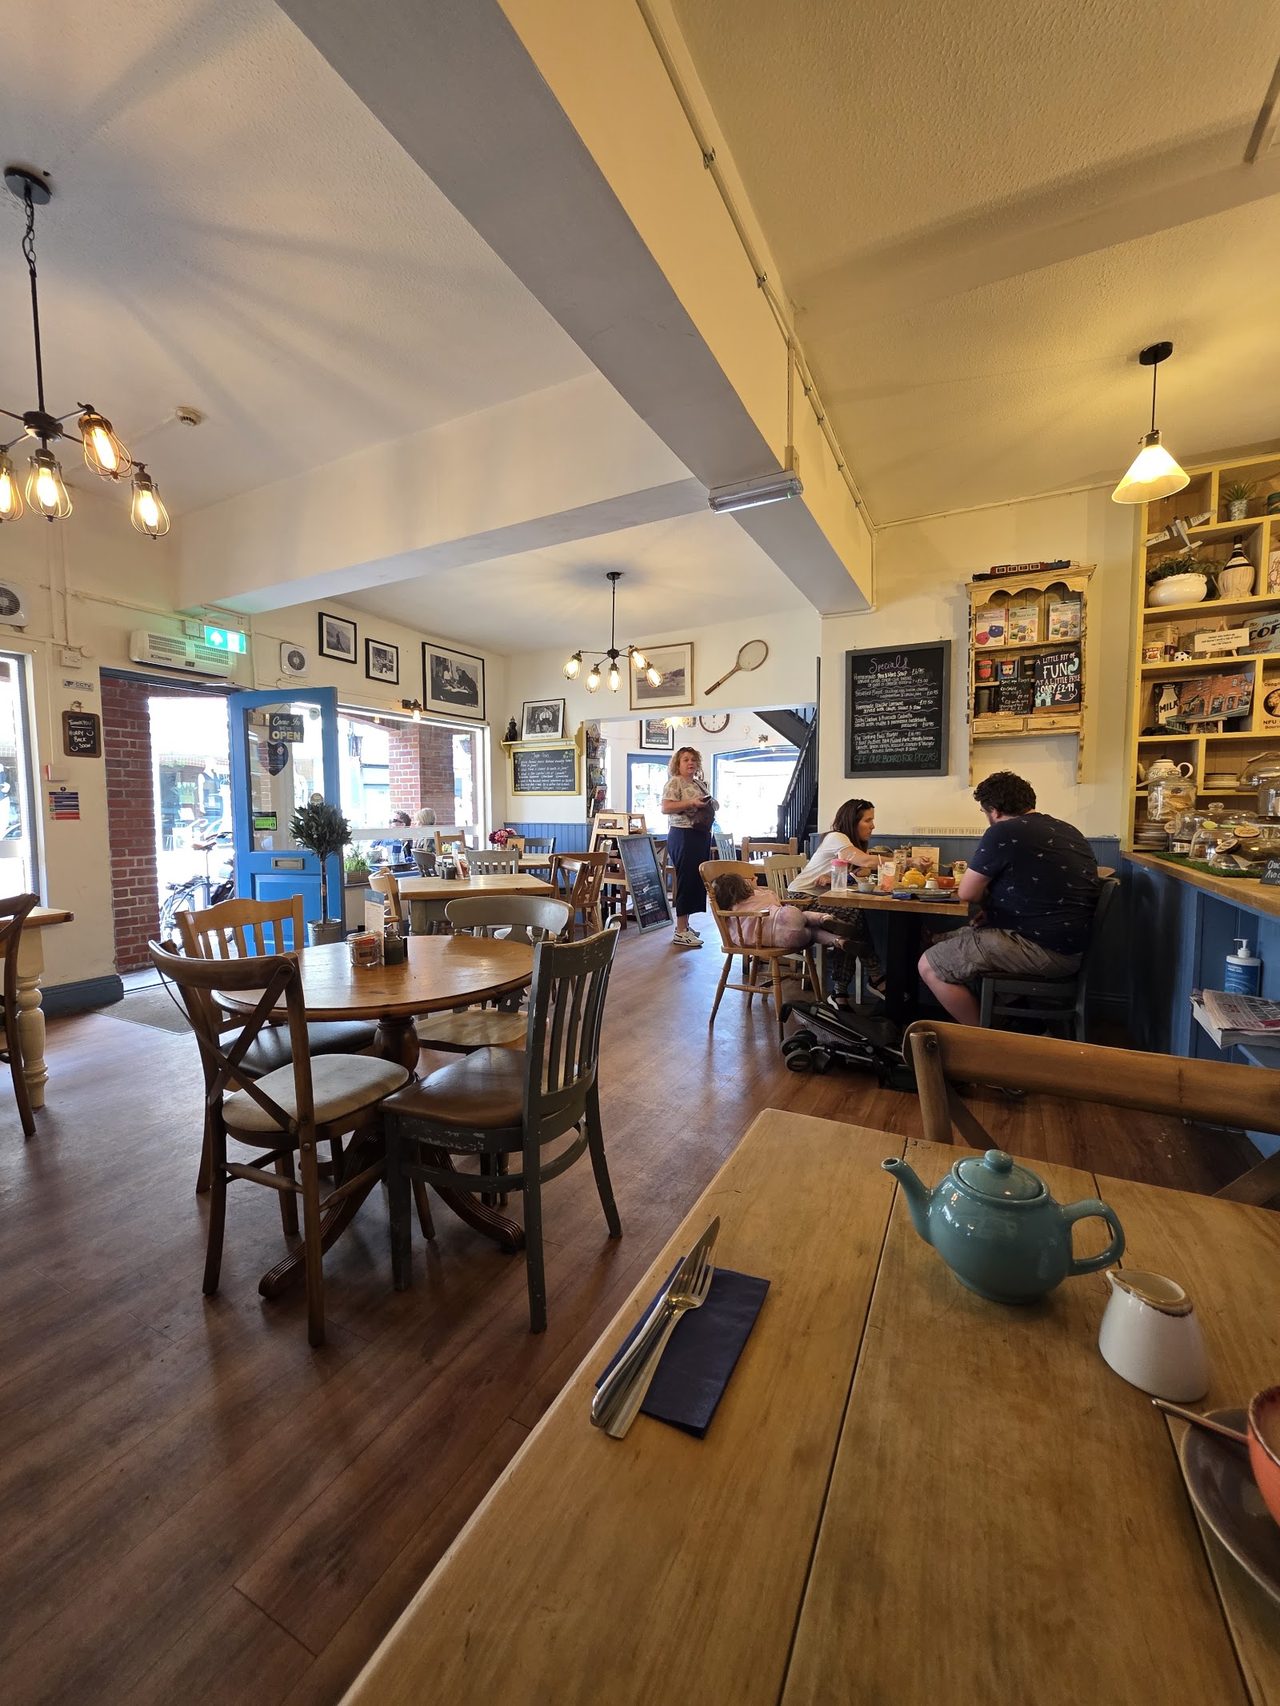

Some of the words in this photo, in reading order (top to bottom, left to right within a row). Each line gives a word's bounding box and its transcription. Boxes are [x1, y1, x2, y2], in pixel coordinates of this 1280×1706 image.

[869, 655, 911, 674] Specials
[1043, 655, 1058, 663] LITTLE
[1043, 662, 1068, 679] FUN
[1160, 700, 1178, 713] MILK
[272, 731, 300, 740] OPEN
